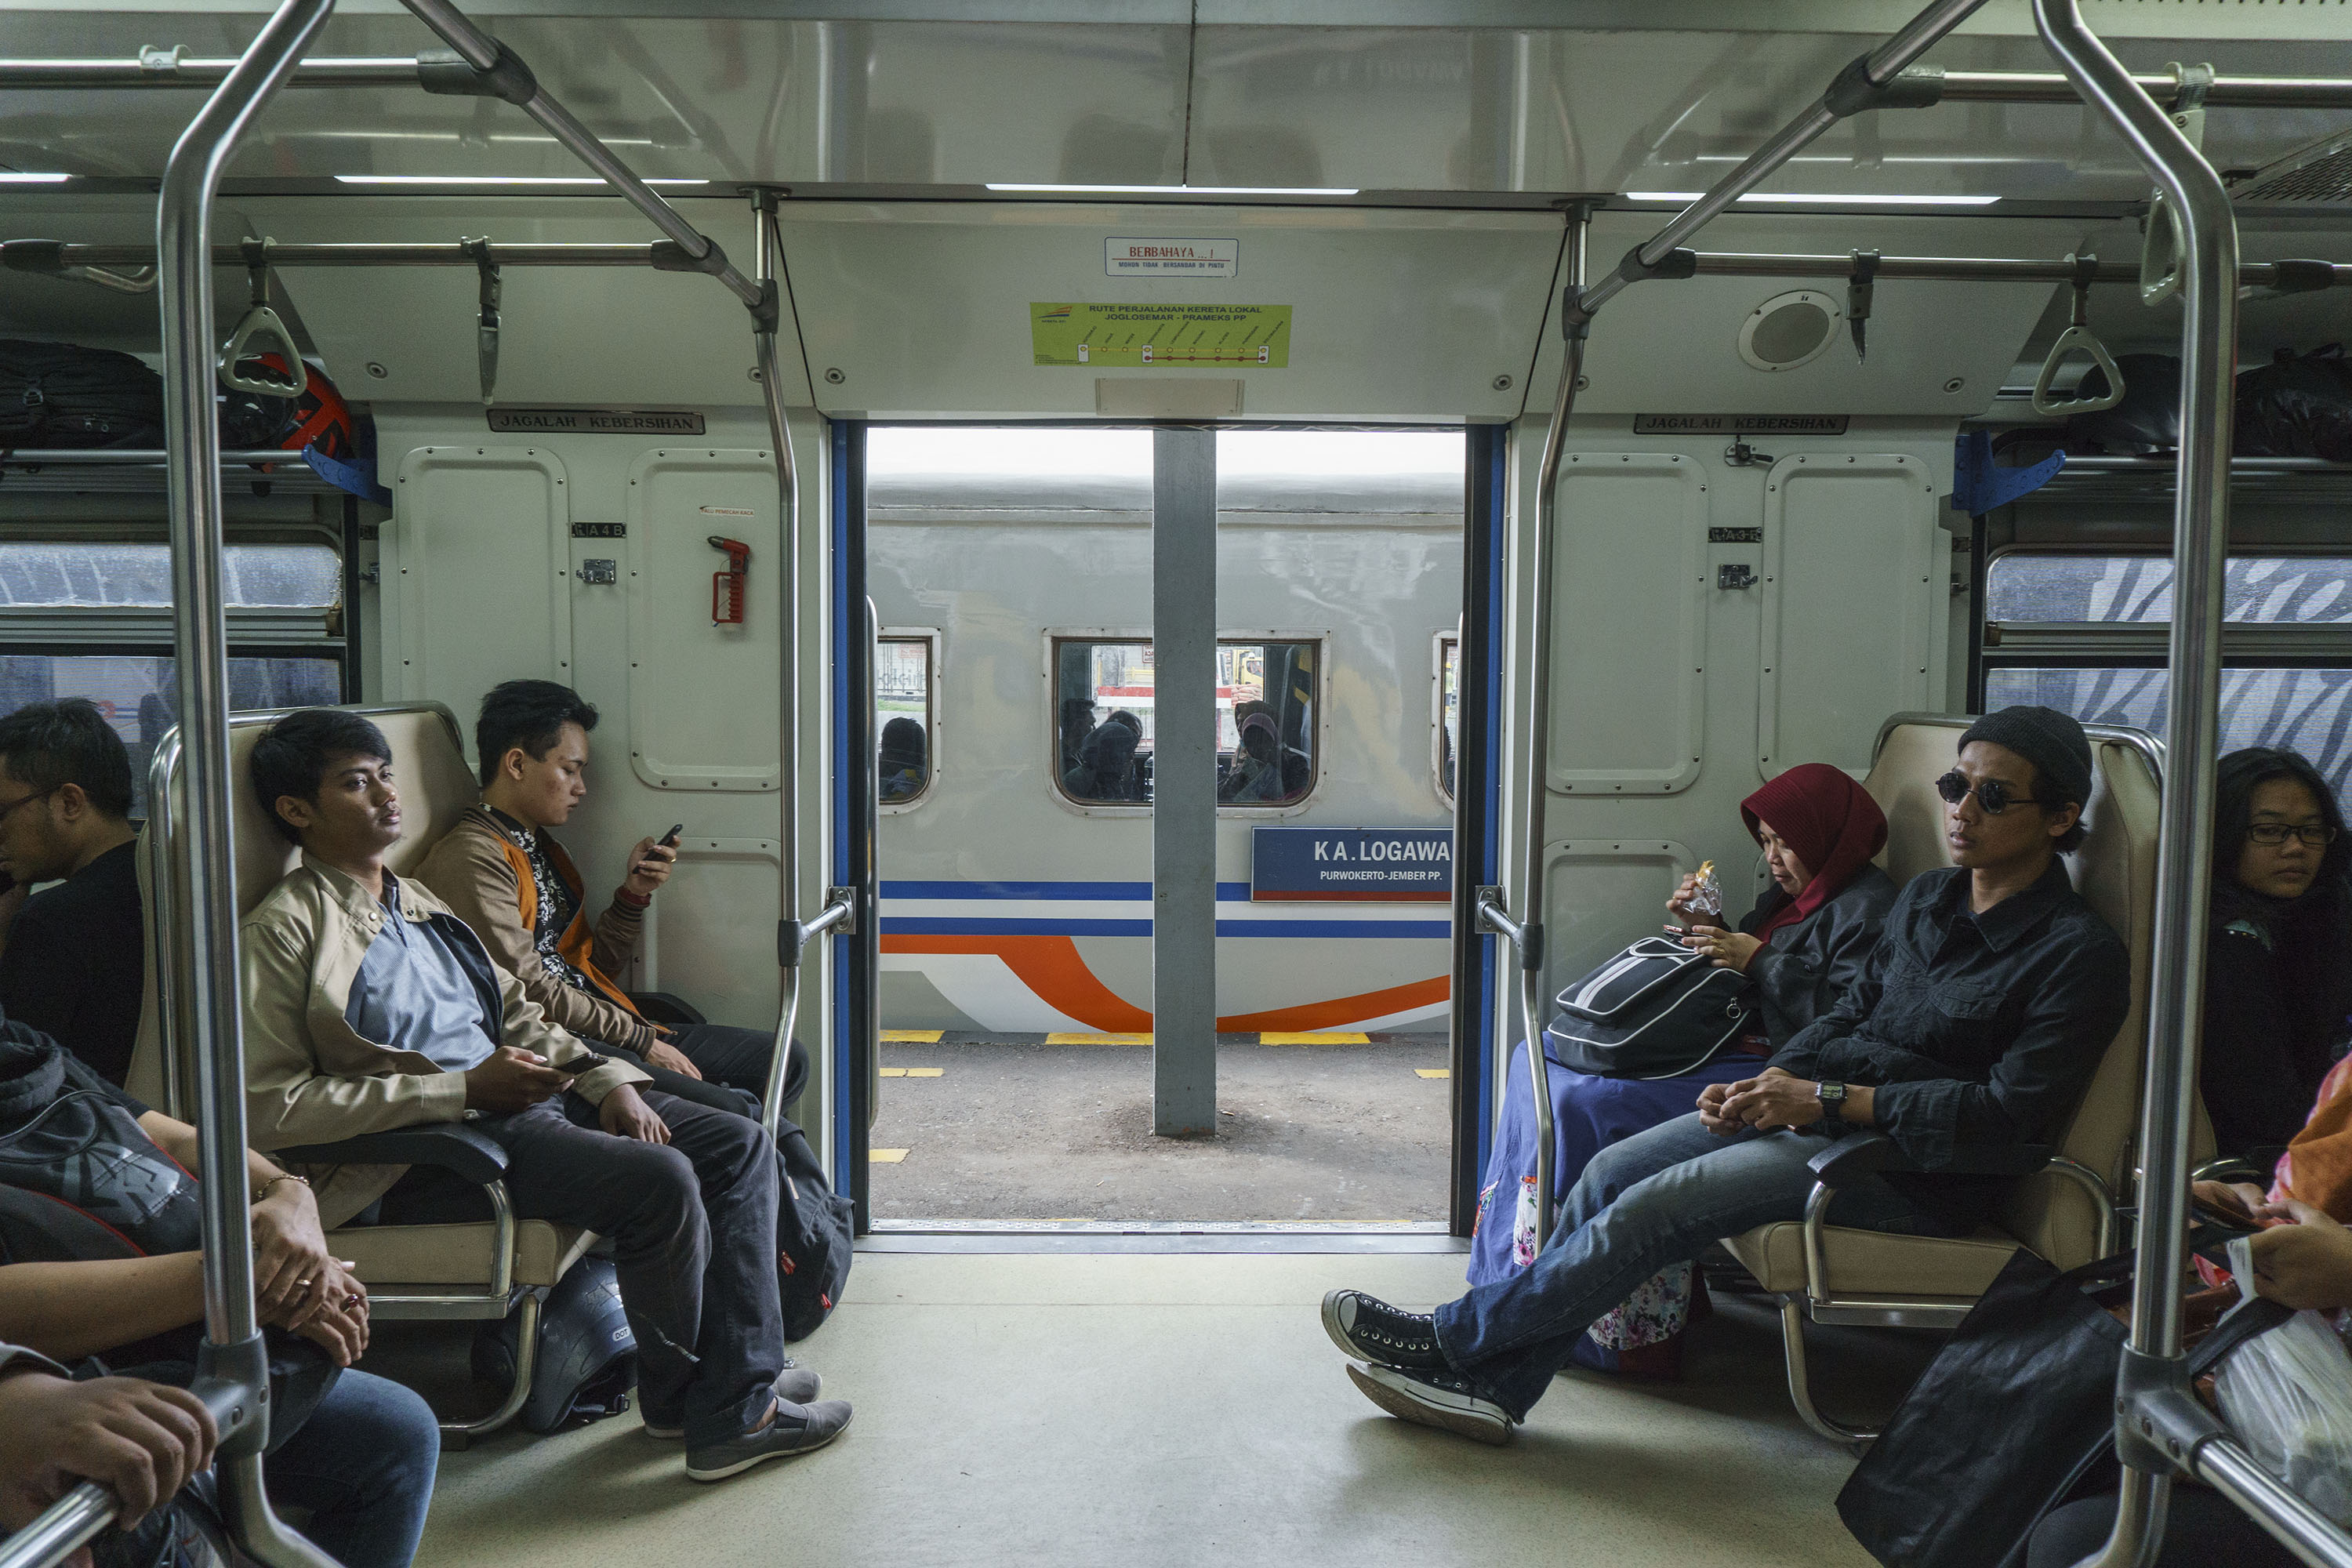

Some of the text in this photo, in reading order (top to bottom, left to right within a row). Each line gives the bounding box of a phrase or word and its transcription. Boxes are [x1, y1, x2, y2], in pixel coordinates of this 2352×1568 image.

[1129, 246, 1194, 258] BERBAHAYA
[500, 416, 693, 429] JAGALAH KEBERSIHAN
[1646, 418, 1838, 429] JAGALAH KEBERSIHAN
[1359, 841, 1450, 861] LOGAWA
[1320, 871, 1443, 880] PURWOKERTO-JEMBER PP.
[615, 1328, 628, 1340] DOT
